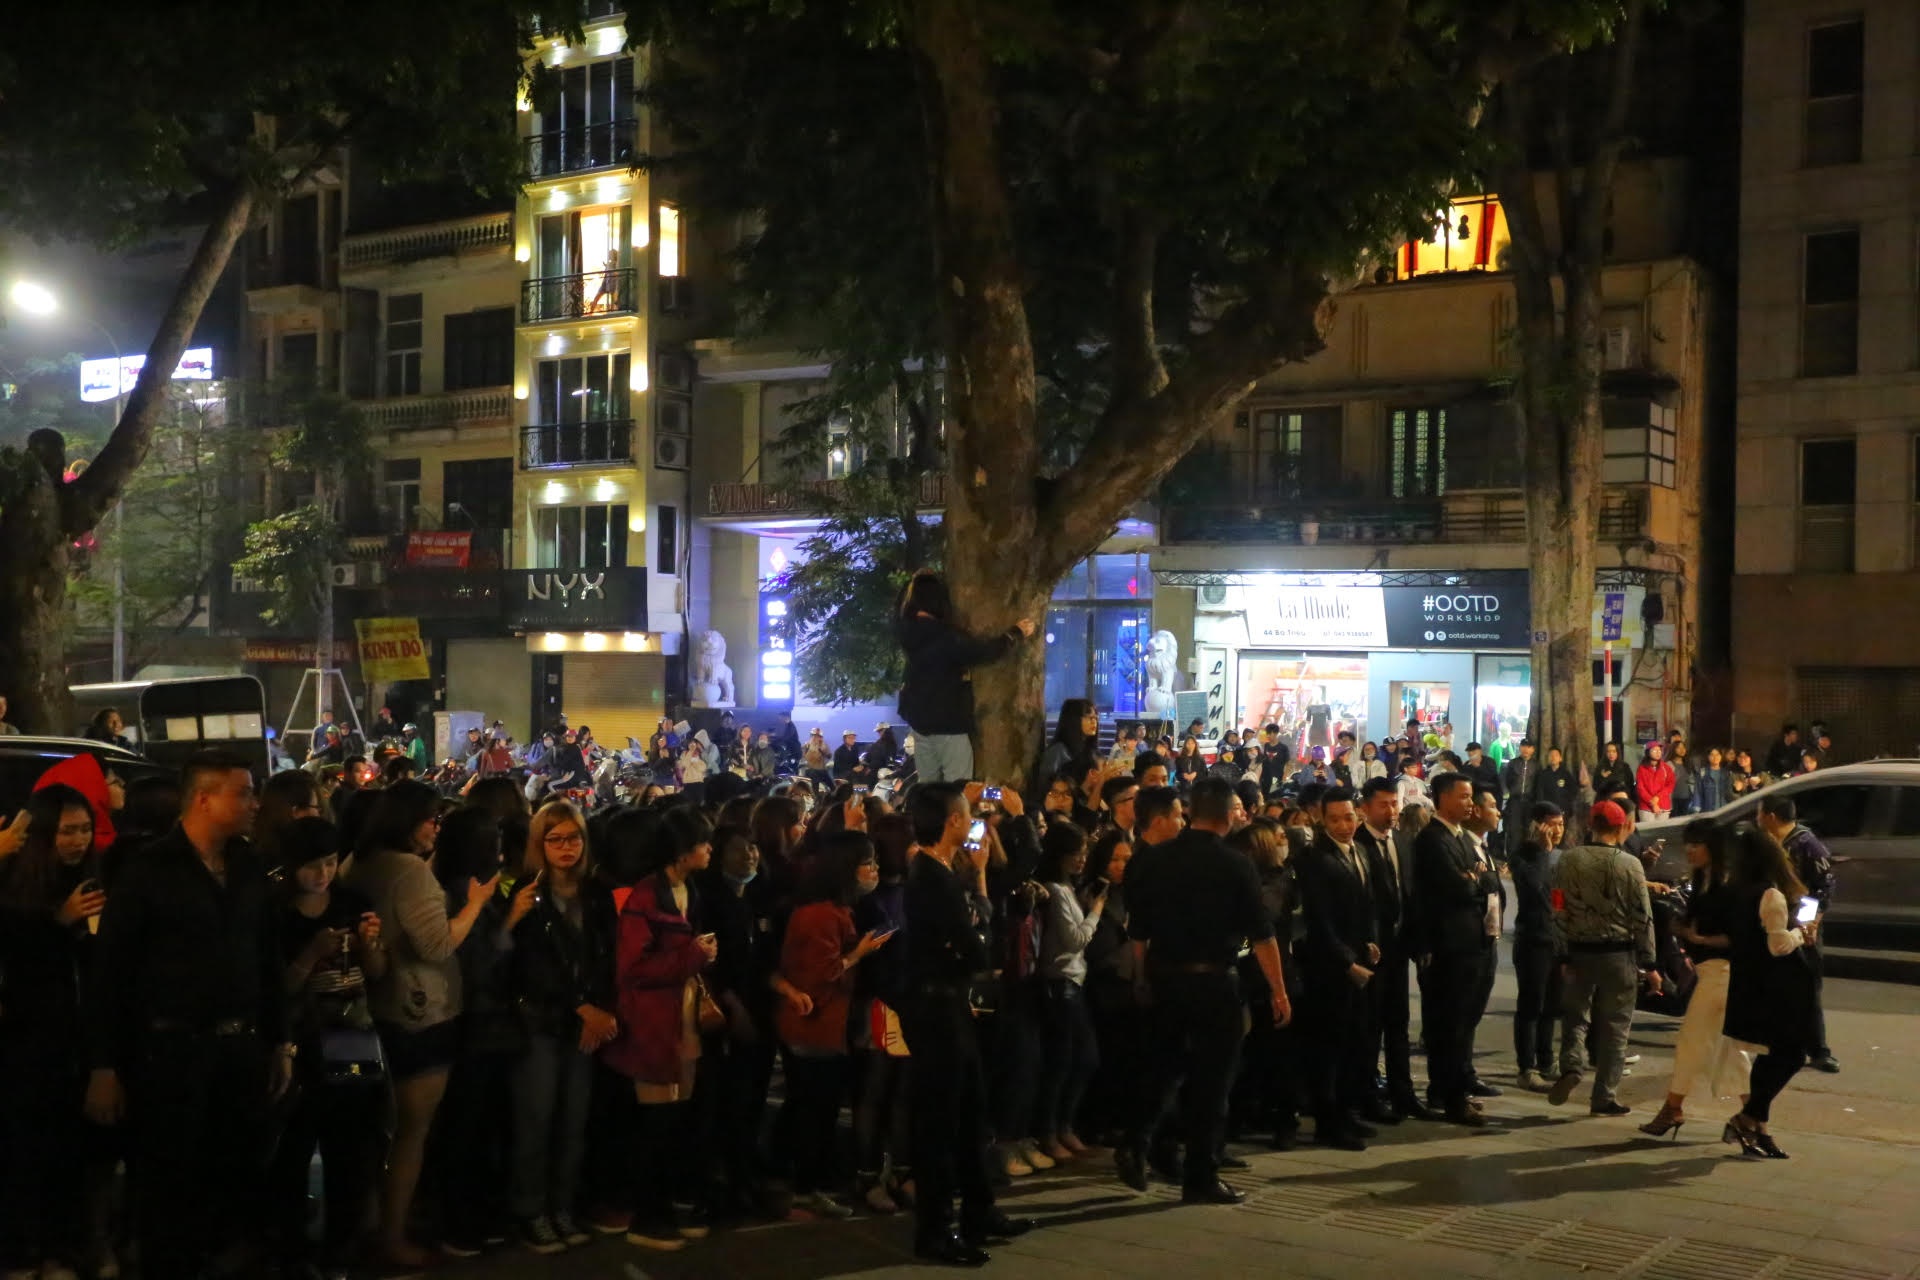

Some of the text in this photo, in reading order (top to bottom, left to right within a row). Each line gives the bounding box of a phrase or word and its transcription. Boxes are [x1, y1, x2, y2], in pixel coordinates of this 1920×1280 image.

[527, 572, 605, 608] NYX
[1423, 595, 1500, 612] #OOTD
[361, 641, 398, 660] KINH
